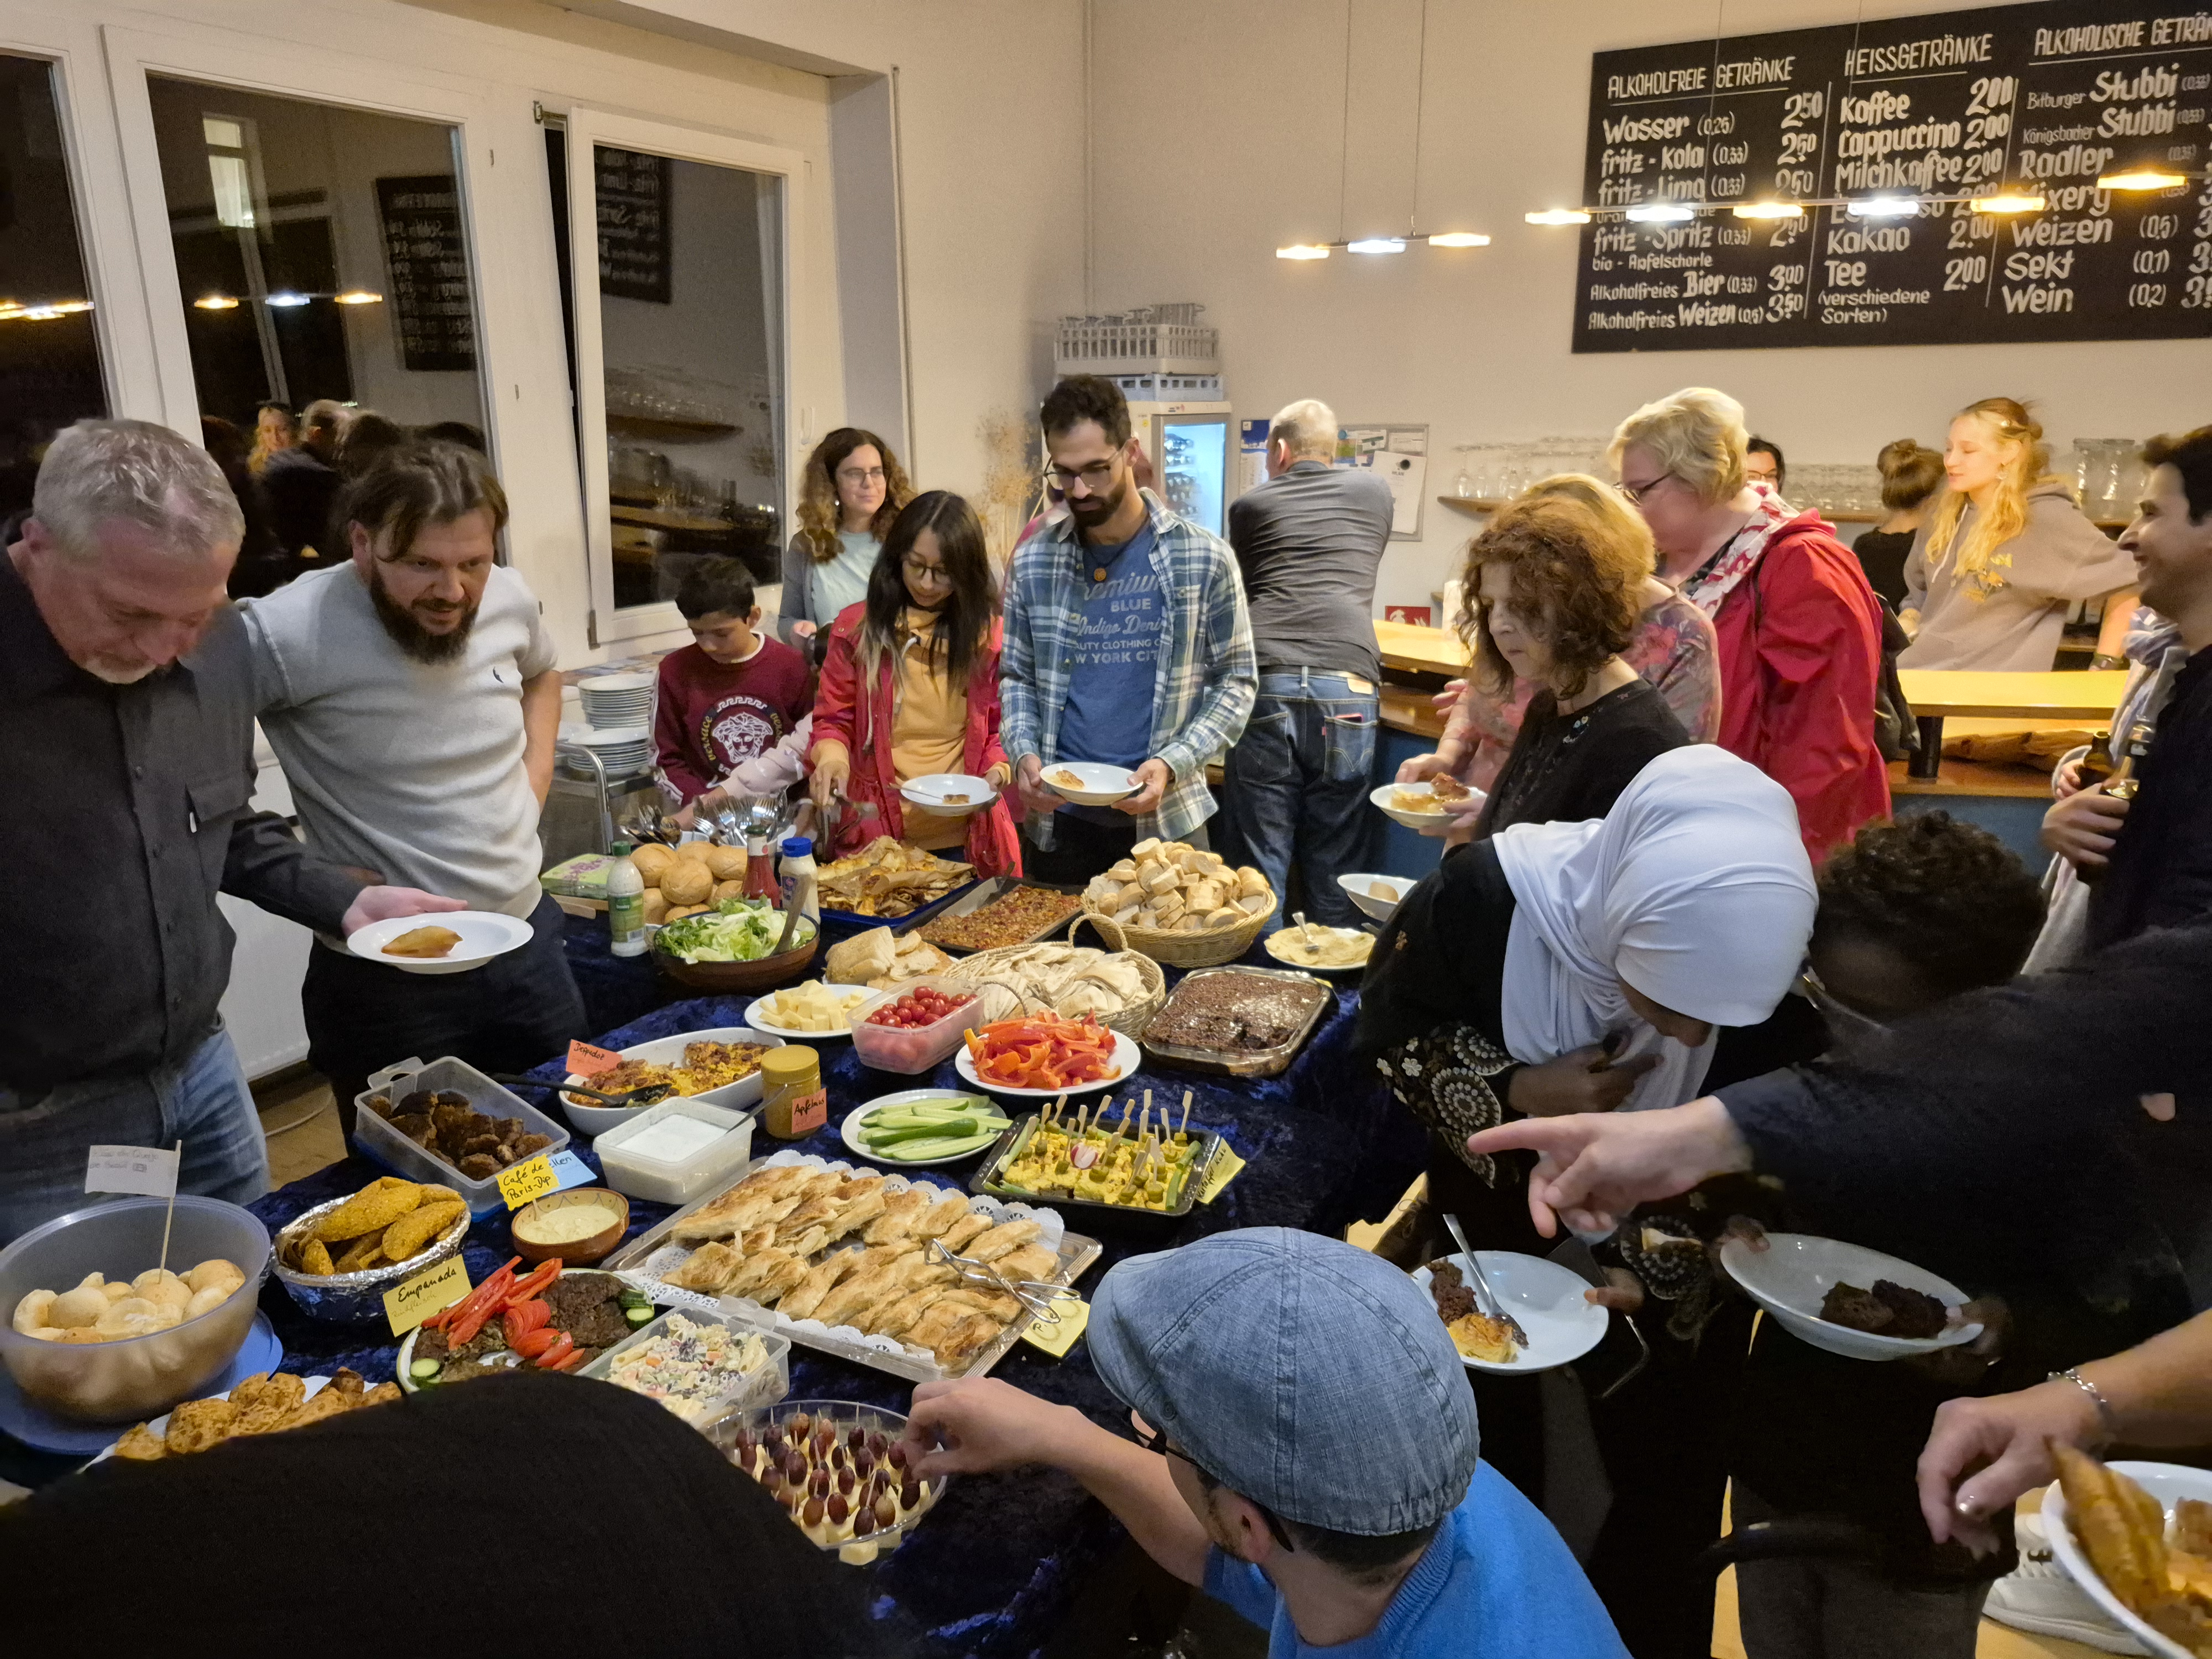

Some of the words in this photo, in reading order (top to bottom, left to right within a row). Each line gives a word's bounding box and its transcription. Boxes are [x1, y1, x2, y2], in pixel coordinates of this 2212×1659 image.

[1844, 33, 1993, 76] HEISSGETRÄNKE
[2034, 21, 2146, 56] ALKOHOLISCHE
[1608, 67, 1707, 100] ALKOHOLFREIE
[1715, 56, 1796, 88] GETRÄNKE
[2027, 92, 2086, 109] Bitburger
[2089, 62, 2179, 102] Stubbi
[1840, 90, 1911, 126] Kaffee
[2096, 100, 2177, 138] Stubbi
[1603, 115, 1690, 145] Wasser
[1839, 116, 1961, 163] Cappuccino
[1601, 148, 1645, 178] fritz
[1661, 142, 1705, 171] Kola
[1836, 149, 1963, 192] Milchkaffee
[2019, 144, 2114, 180] Radler
[1598, 177, 1642, 206] fritz
[1594, 226, 1637, 256] fritz
[1827, 226, 1910, 255] Kakao
[2011, 215, 2113, 248] Weizen
[1629, 251, 1713, 272] Apfelschorle
[1824, 260, 1866, 287] Tee
[2004, 249, 2075, 281] Sekt
[1590, 281, 1678, 301] Alkoholfreies
[1682, 269, 1726, 298] Bier
[1818, 288, 1930, 306] (verschiedene
[2002, 281, 2074, 314] Wein
[1588, 310, 1676, 331] Alkoholfreies
[1678, 301, 1735, 327] Weizen
[1820, 306, 1887, 324] Sorten)
[1110, 598, 1151, 612] BLUE
[1077, 616, 1121, 639] Indigo
[1078, 641, 1100, 651] UTY
[1102, 639, 1151, 650] CLOTHING
[1092, 651, 1131, 664] YORK
[503, 1166, 528, 1186] Café
[531, 1164, 544, 1173] de
[398, 1266, 457, 1302] Empanada
